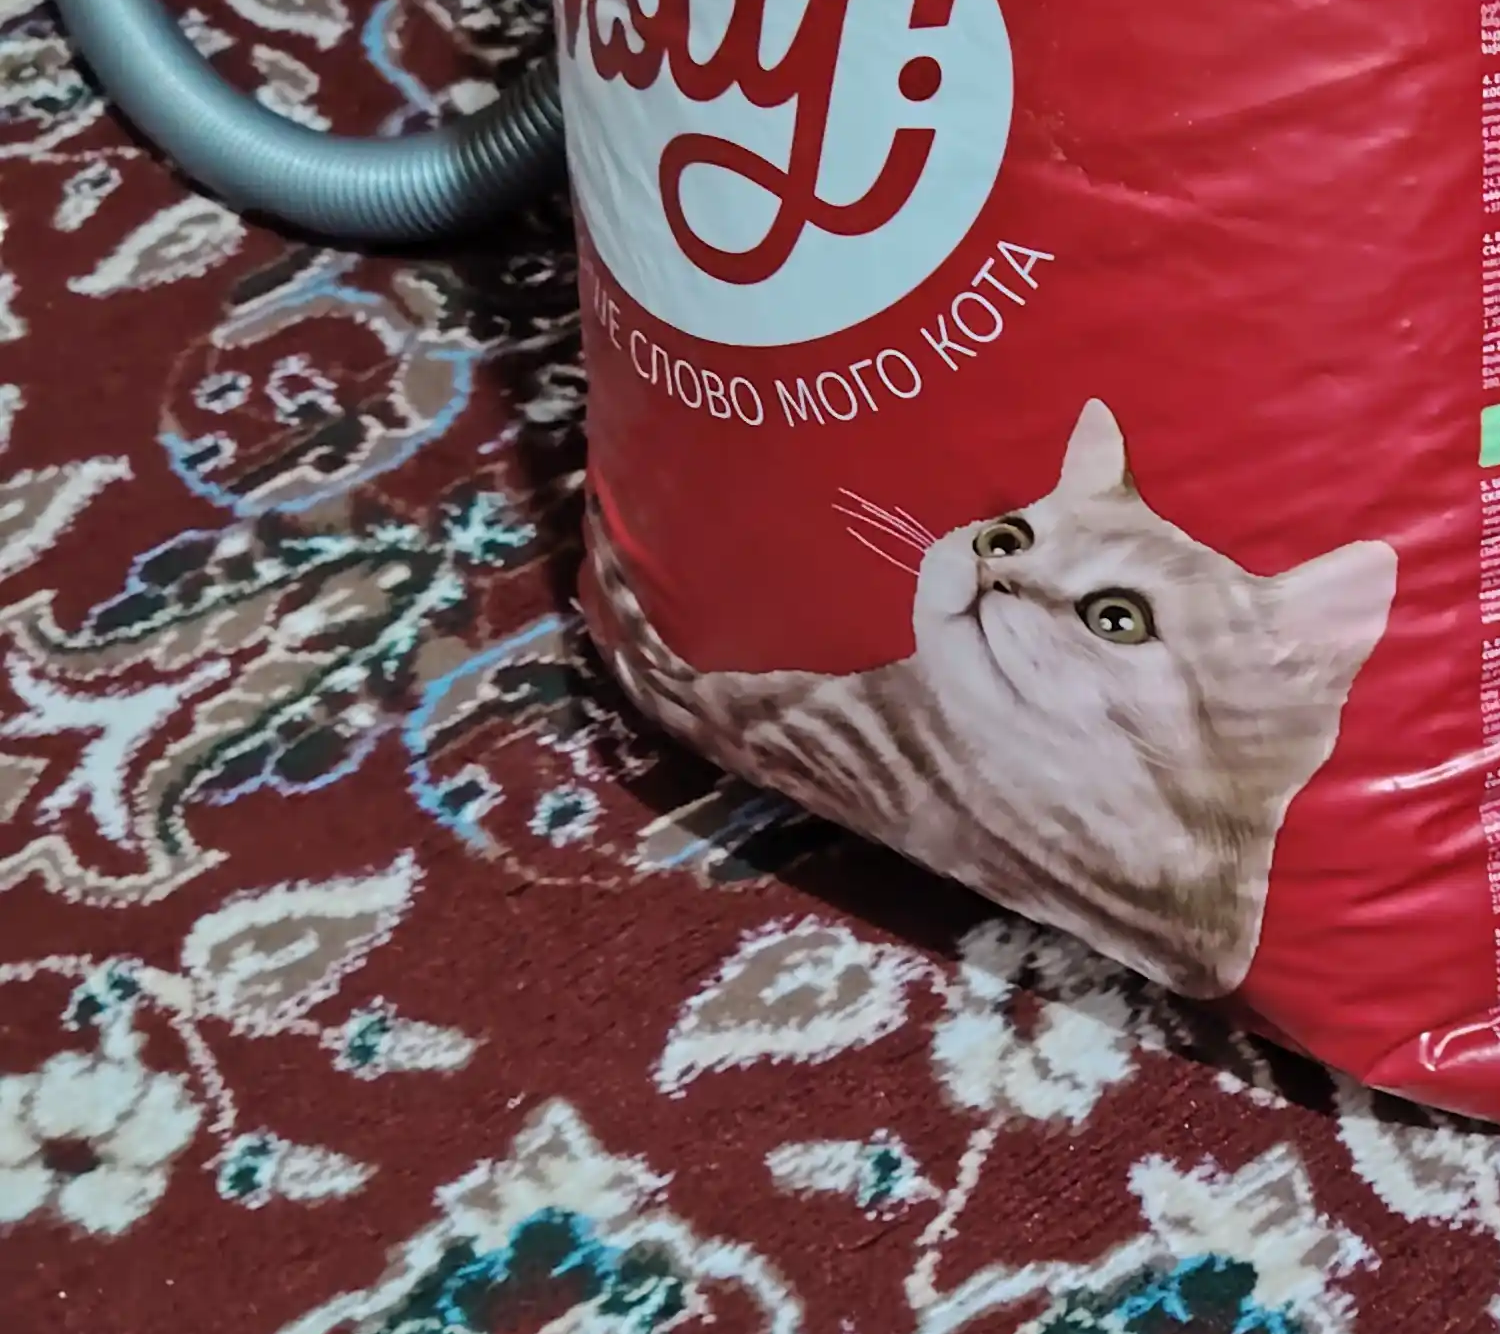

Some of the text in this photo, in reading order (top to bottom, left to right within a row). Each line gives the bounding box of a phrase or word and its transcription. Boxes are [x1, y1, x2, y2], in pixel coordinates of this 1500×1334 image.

[630, 240, 1055, 427] СЛОВО МОГО КОТА
